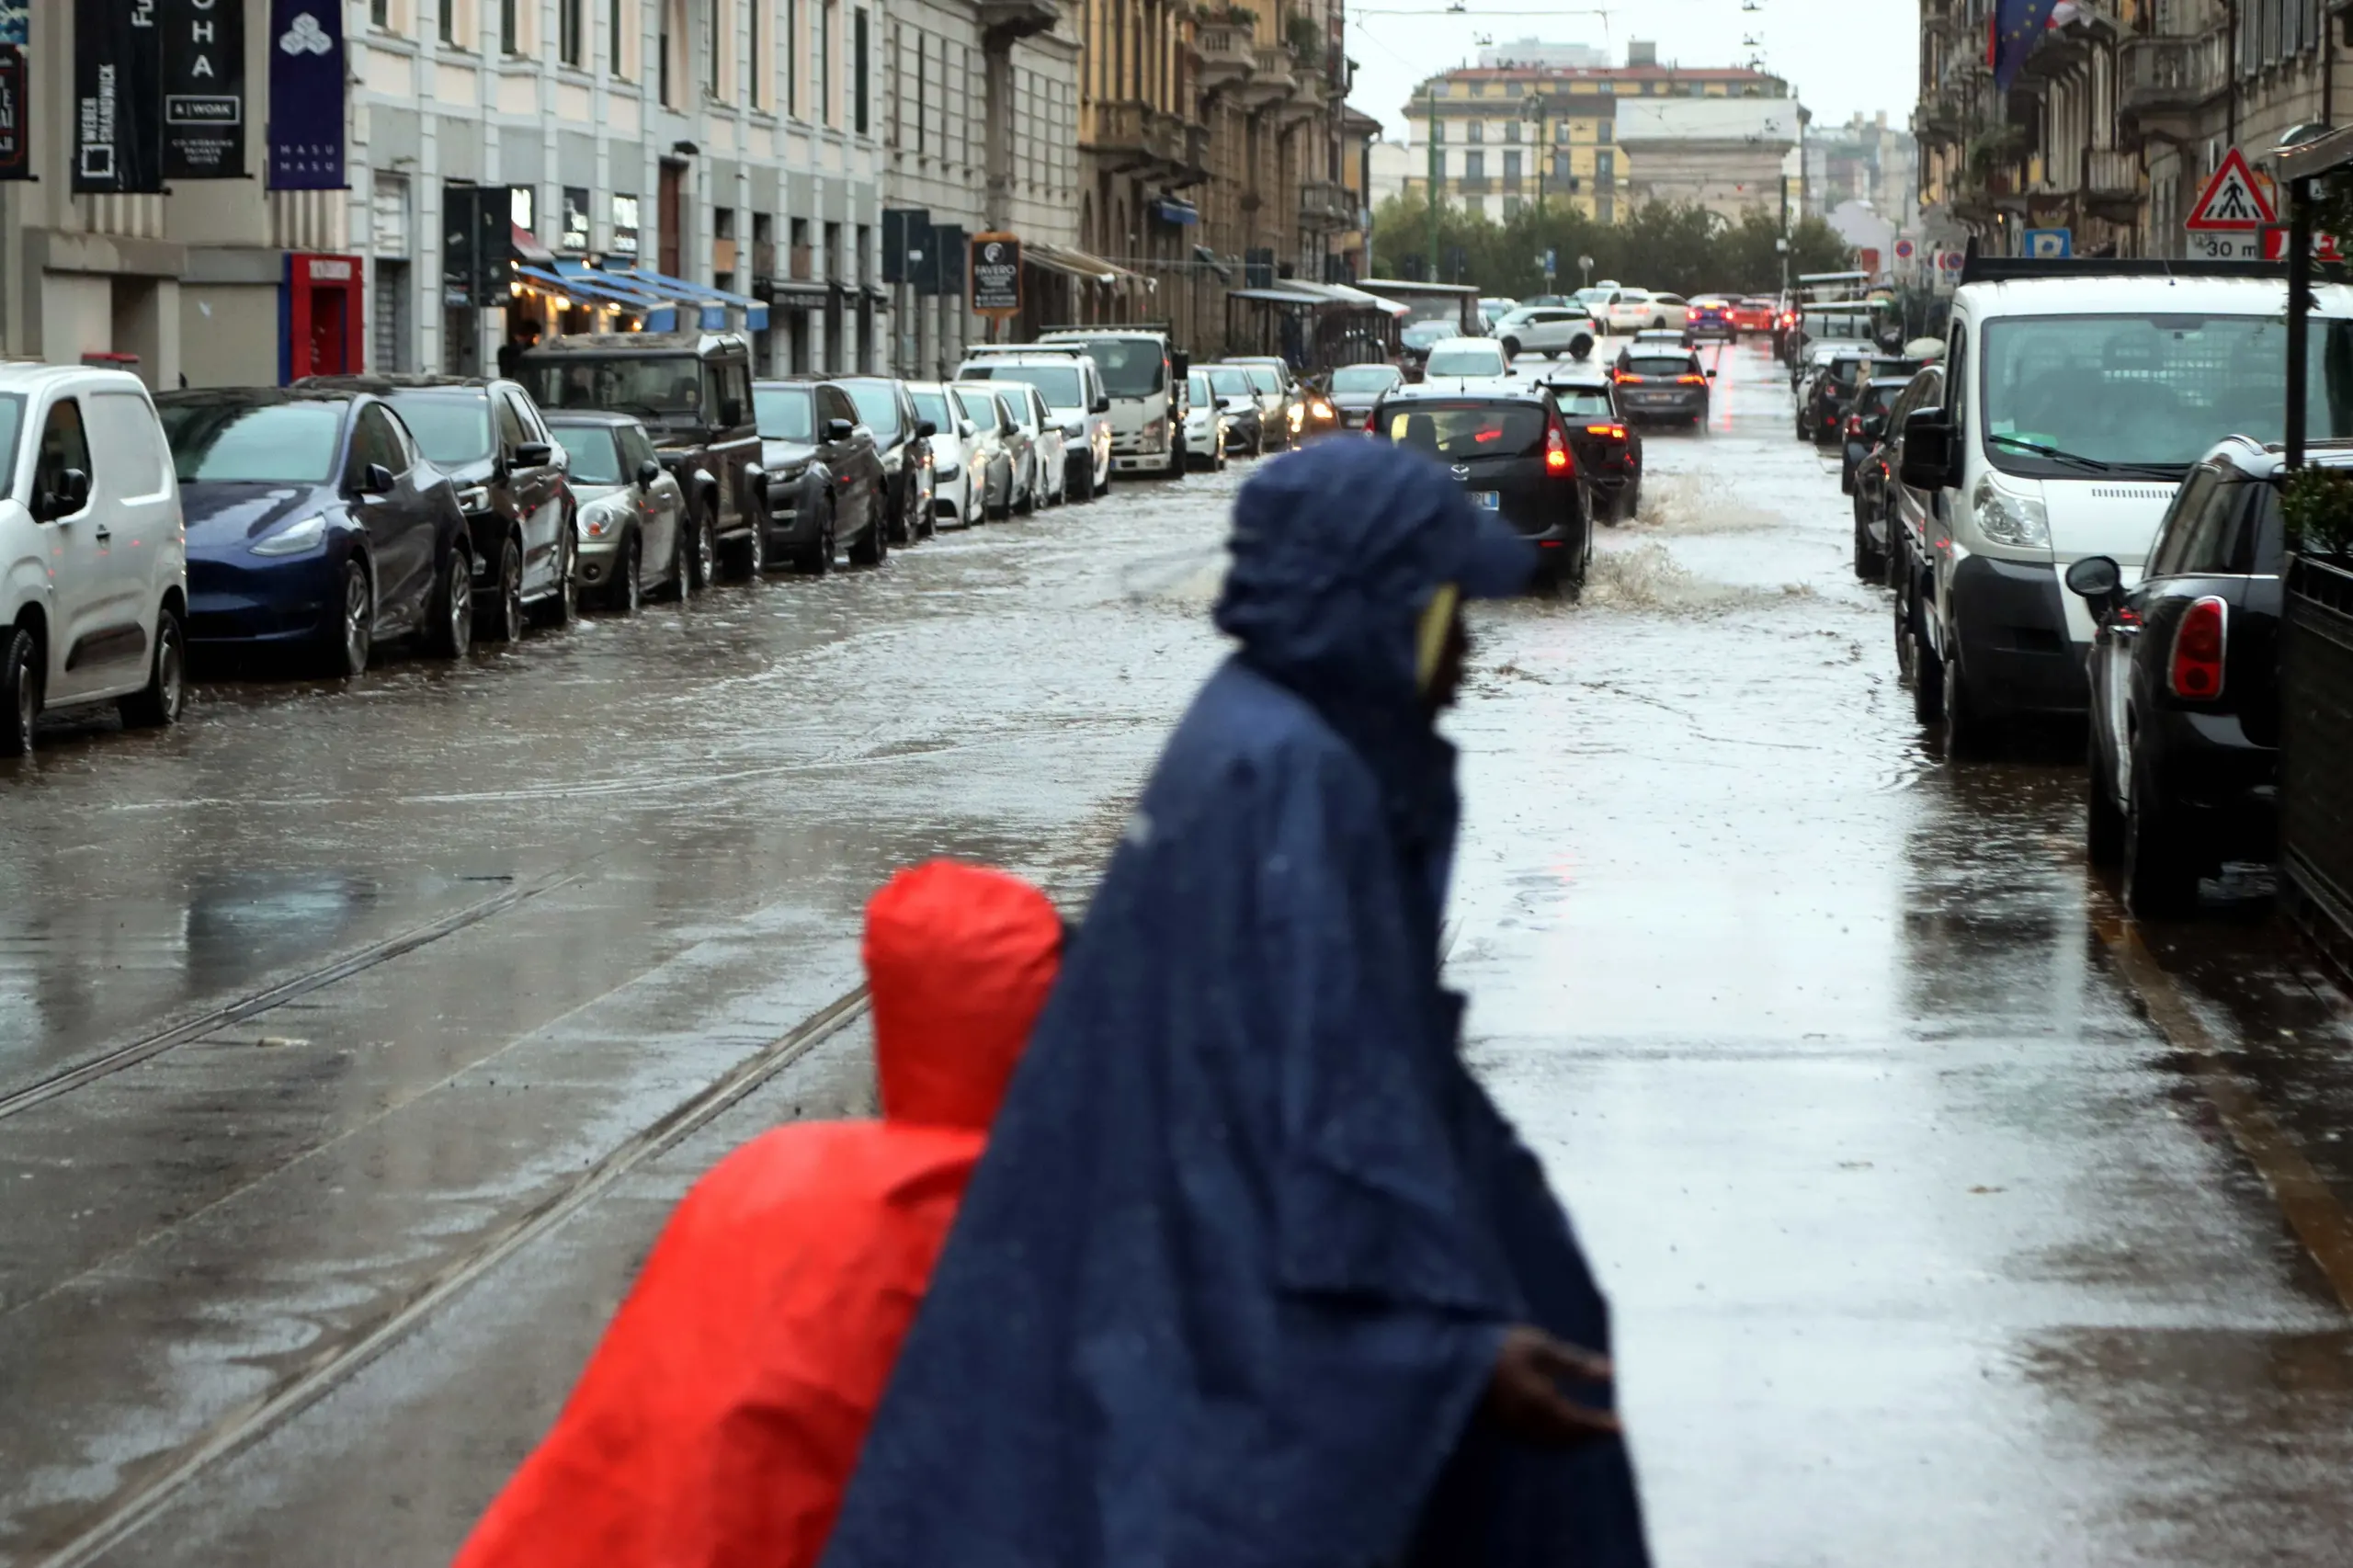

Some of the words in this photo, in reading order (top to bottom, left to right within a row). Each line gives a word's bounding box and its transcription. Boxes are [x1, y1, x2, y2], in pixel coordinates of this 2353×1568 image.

[98, 64, 115, 142] SHANDWICK
[193, 104, 231, 115] WORK
[82, 97, 97, 142] WEBER
[2207, 241, 2233, 256] 30
